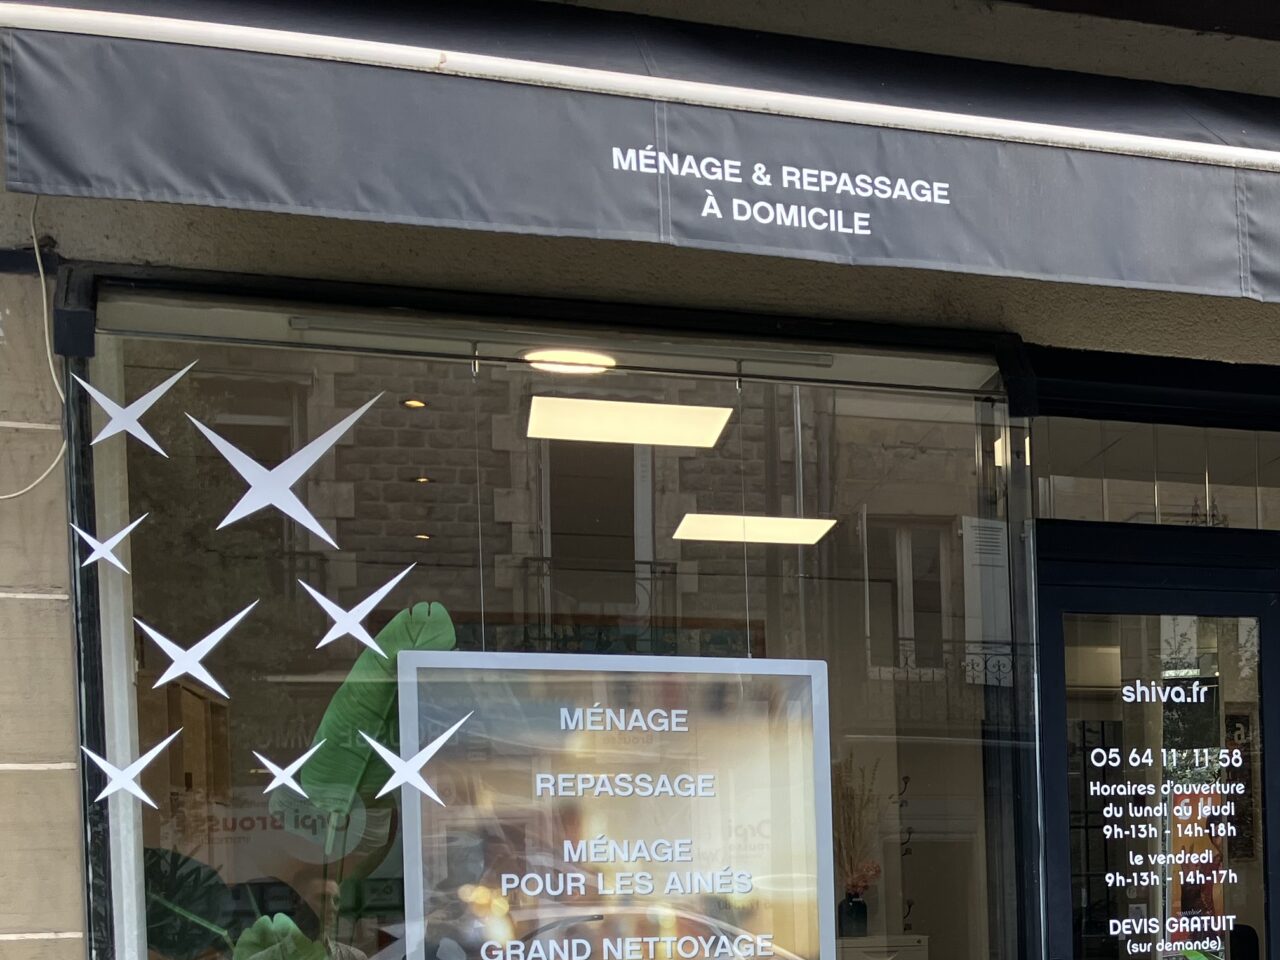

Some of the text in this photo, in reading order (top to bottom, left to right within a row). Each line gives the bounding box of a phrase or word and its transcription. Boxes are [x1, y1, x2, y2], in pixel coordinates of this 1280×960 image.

[612, 145, 951, 204] MÉNAGE & REPASSAGE
[701, 189, 871, 235] À DOMICILE
[1122, 680, 1208, 703] shiva.fr
[560, 702, 689, 732] MÉNAGE
[1090, 748, 1243, 767] 05 64 11 11 58
[535, 773, 716, 797] REPASSAGE
[1089, 780, 1245, 796] Horaires d'ouverture
[1103, 803, 1123, 818] du
[1129, 802, 1168, 817] lundi
[1173, 806, 1192, 817] au
[1197, 801, 1236, 820] jeudi
[1103, 824, 1158, 839] 9h-13h
[1176, 822, 1237, 838] 14h-18h
[563, 834, 693, 863] MÉNAGE
[1129, 849, 1213, 865] le vendredi
[501, 866, 753, 897] POUR LES AINÉS
[1105, 872, 1160, 887] 9h-13h
[1179, 870, 1238, 885] 14h-17h
[1109, 915, 1236, 935] DEVIS GRATUIT
[1126, 936, 1221, 955] (sur demande)
